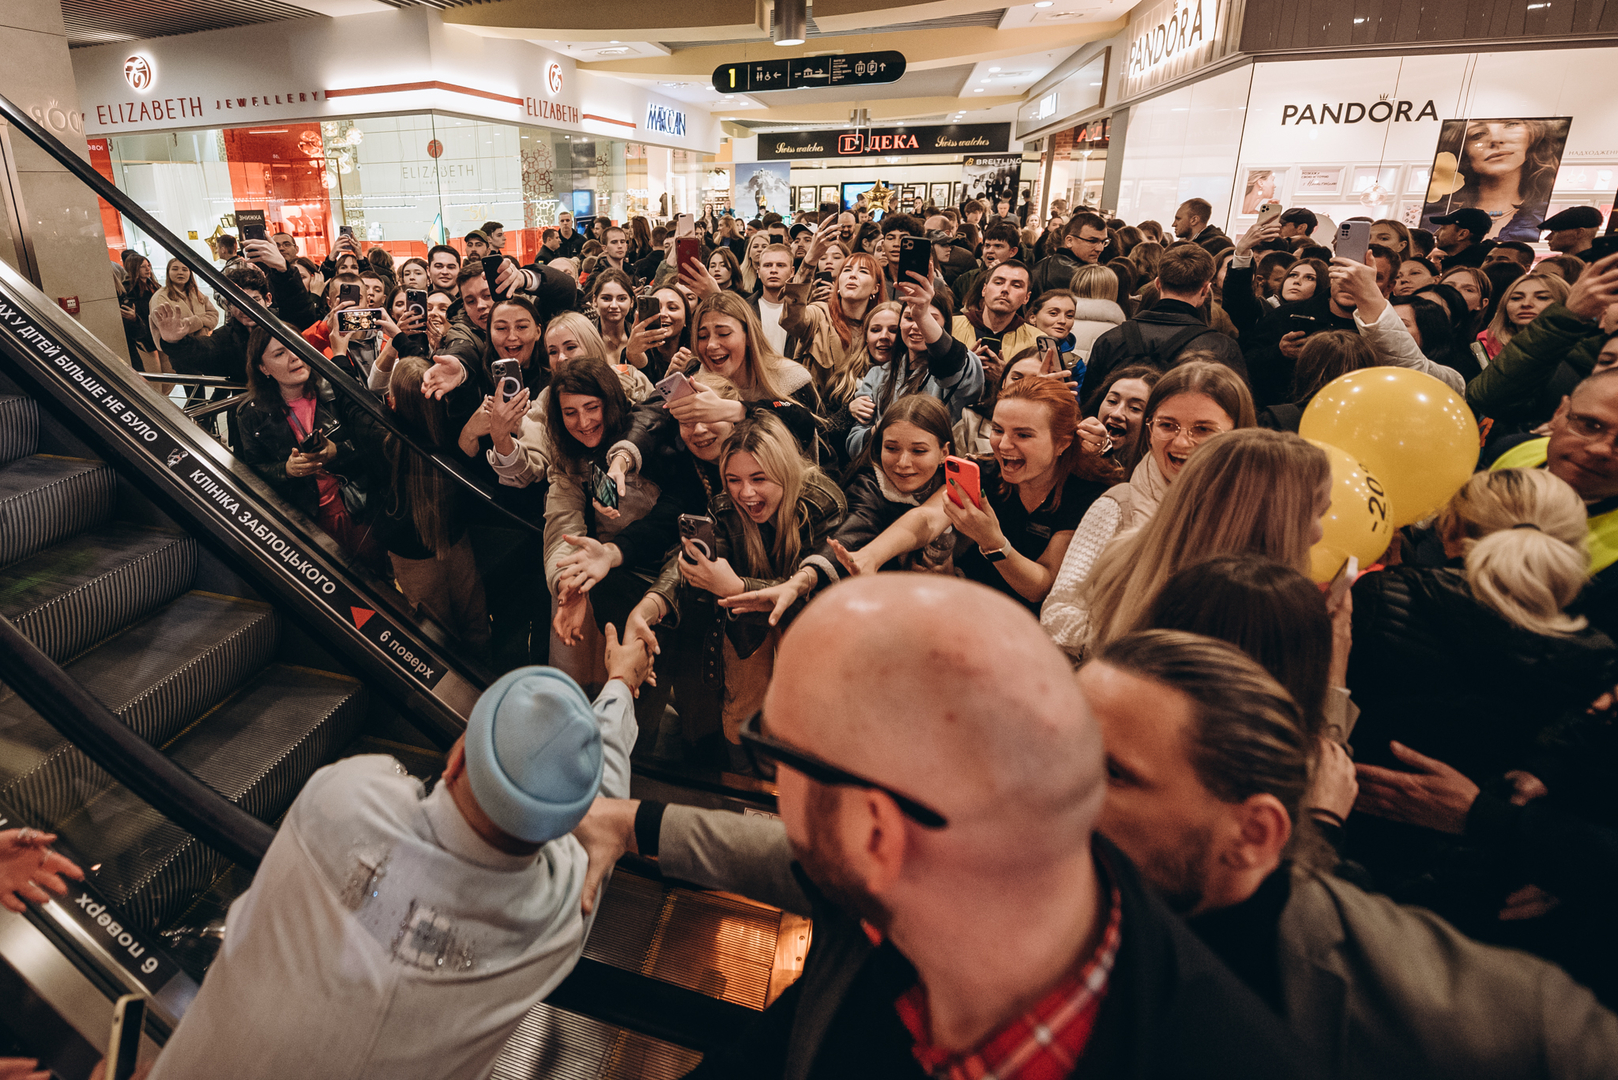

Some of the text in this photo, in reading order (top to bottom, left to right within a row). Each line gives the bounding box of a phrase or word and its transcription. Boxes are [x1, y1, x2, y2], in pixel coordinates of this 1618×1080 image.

[1129, 0, 1202, 75] PANDORA
[728, 68, 736, 88] 1
[96, 91, 318, 125] ELIZABETH JEWELLERY
[526, 97, 579, 124] ELIZABETH
[1281, 99, 1439, 126] PANDORA
[775, 142, 824, 153] Swiss watches
[866, 134, 919, 153] ДЕКА
[935, 135, 990, 147] Swiss watches
[402, 164, 474, 179] ELIZABETH
[976, 157, 1022, 166] BREITLING
[10, 316, 26, 325] У
[17, 325, 62, 358] ДІТЕЙ
[54, 354, 107, 398] БІЛЬШЕ
[101, 394, 125, 414] НЕ
[120, 411, 158, 442] БУЛО
[189, 468, 336, 595] КЛІНІКА ЗАБЛОЦЬКОГО
[379, 630, 435, 680] 6 поверх
[75, 892, 159, 974] 6 поверх
